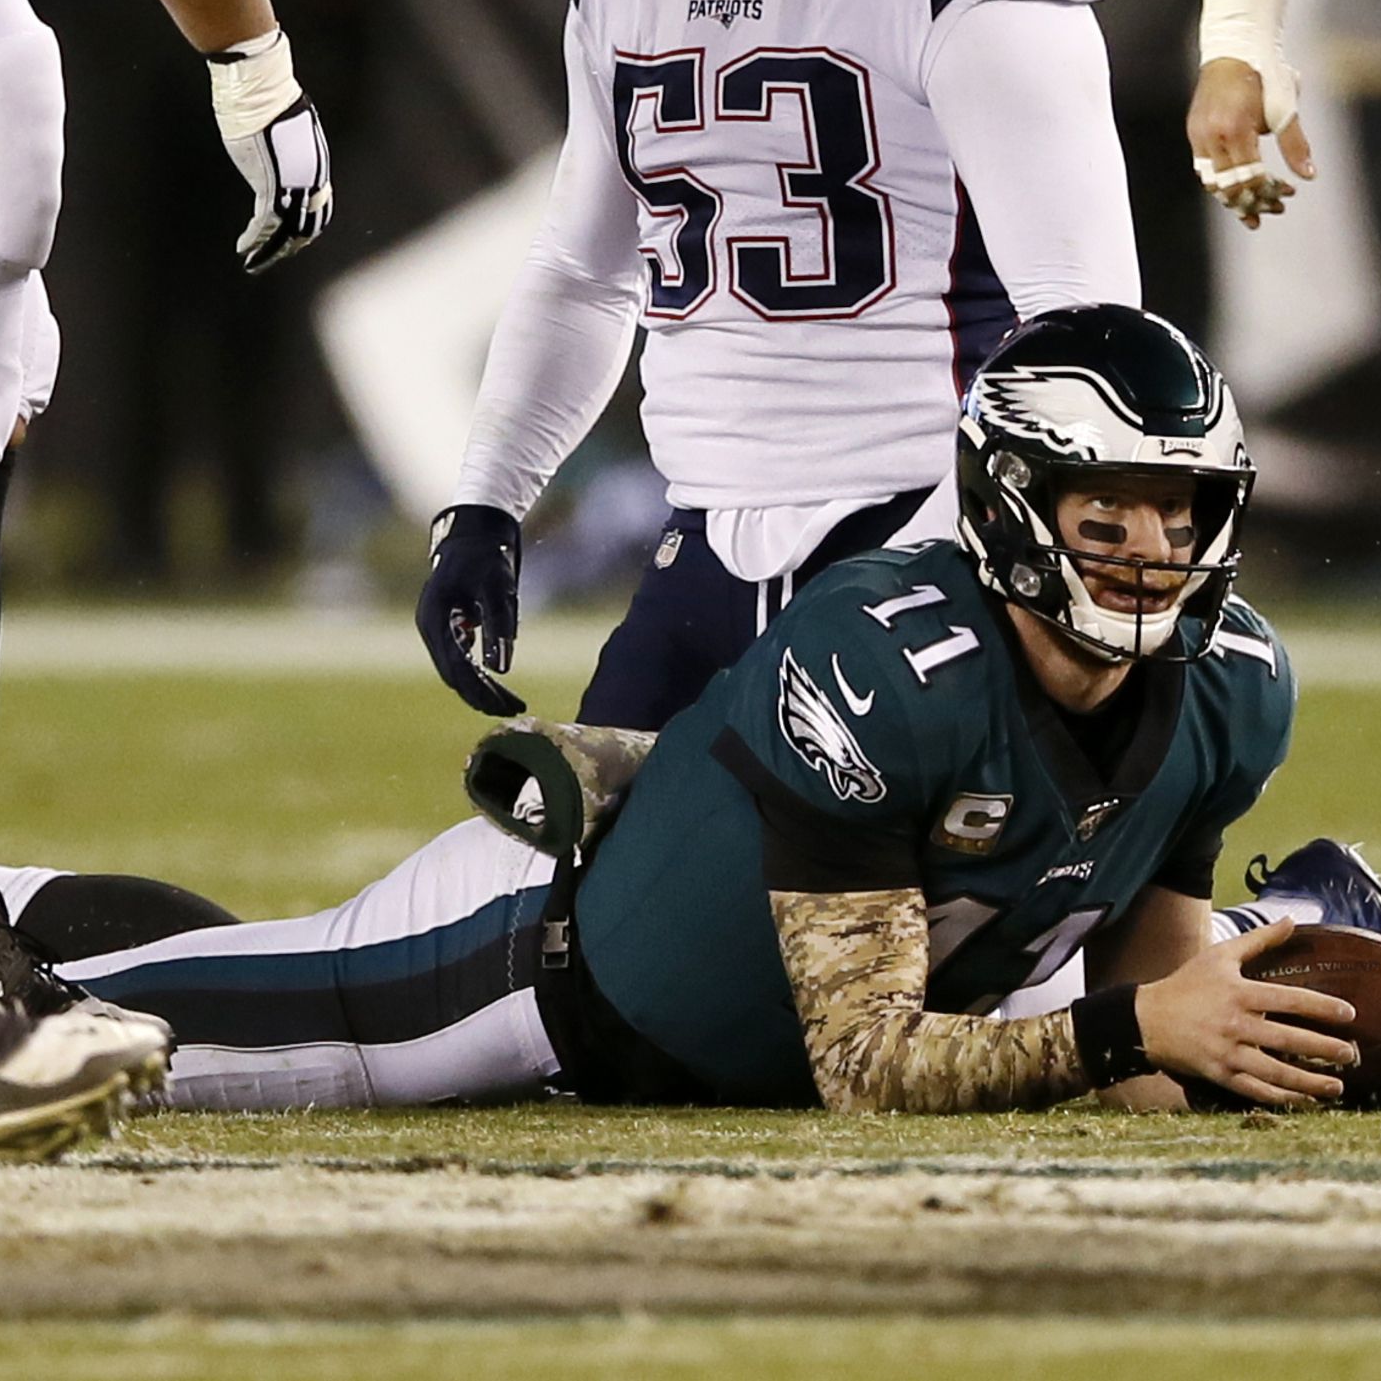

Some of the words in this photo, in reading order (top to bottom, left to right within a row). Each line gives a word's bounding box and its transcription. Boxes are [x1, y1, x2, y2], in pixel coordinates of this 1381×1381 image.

[613, 47, 897, 321] 53
[861, 583, 981, 684] 11
[943, 796, 1008, 840] C
